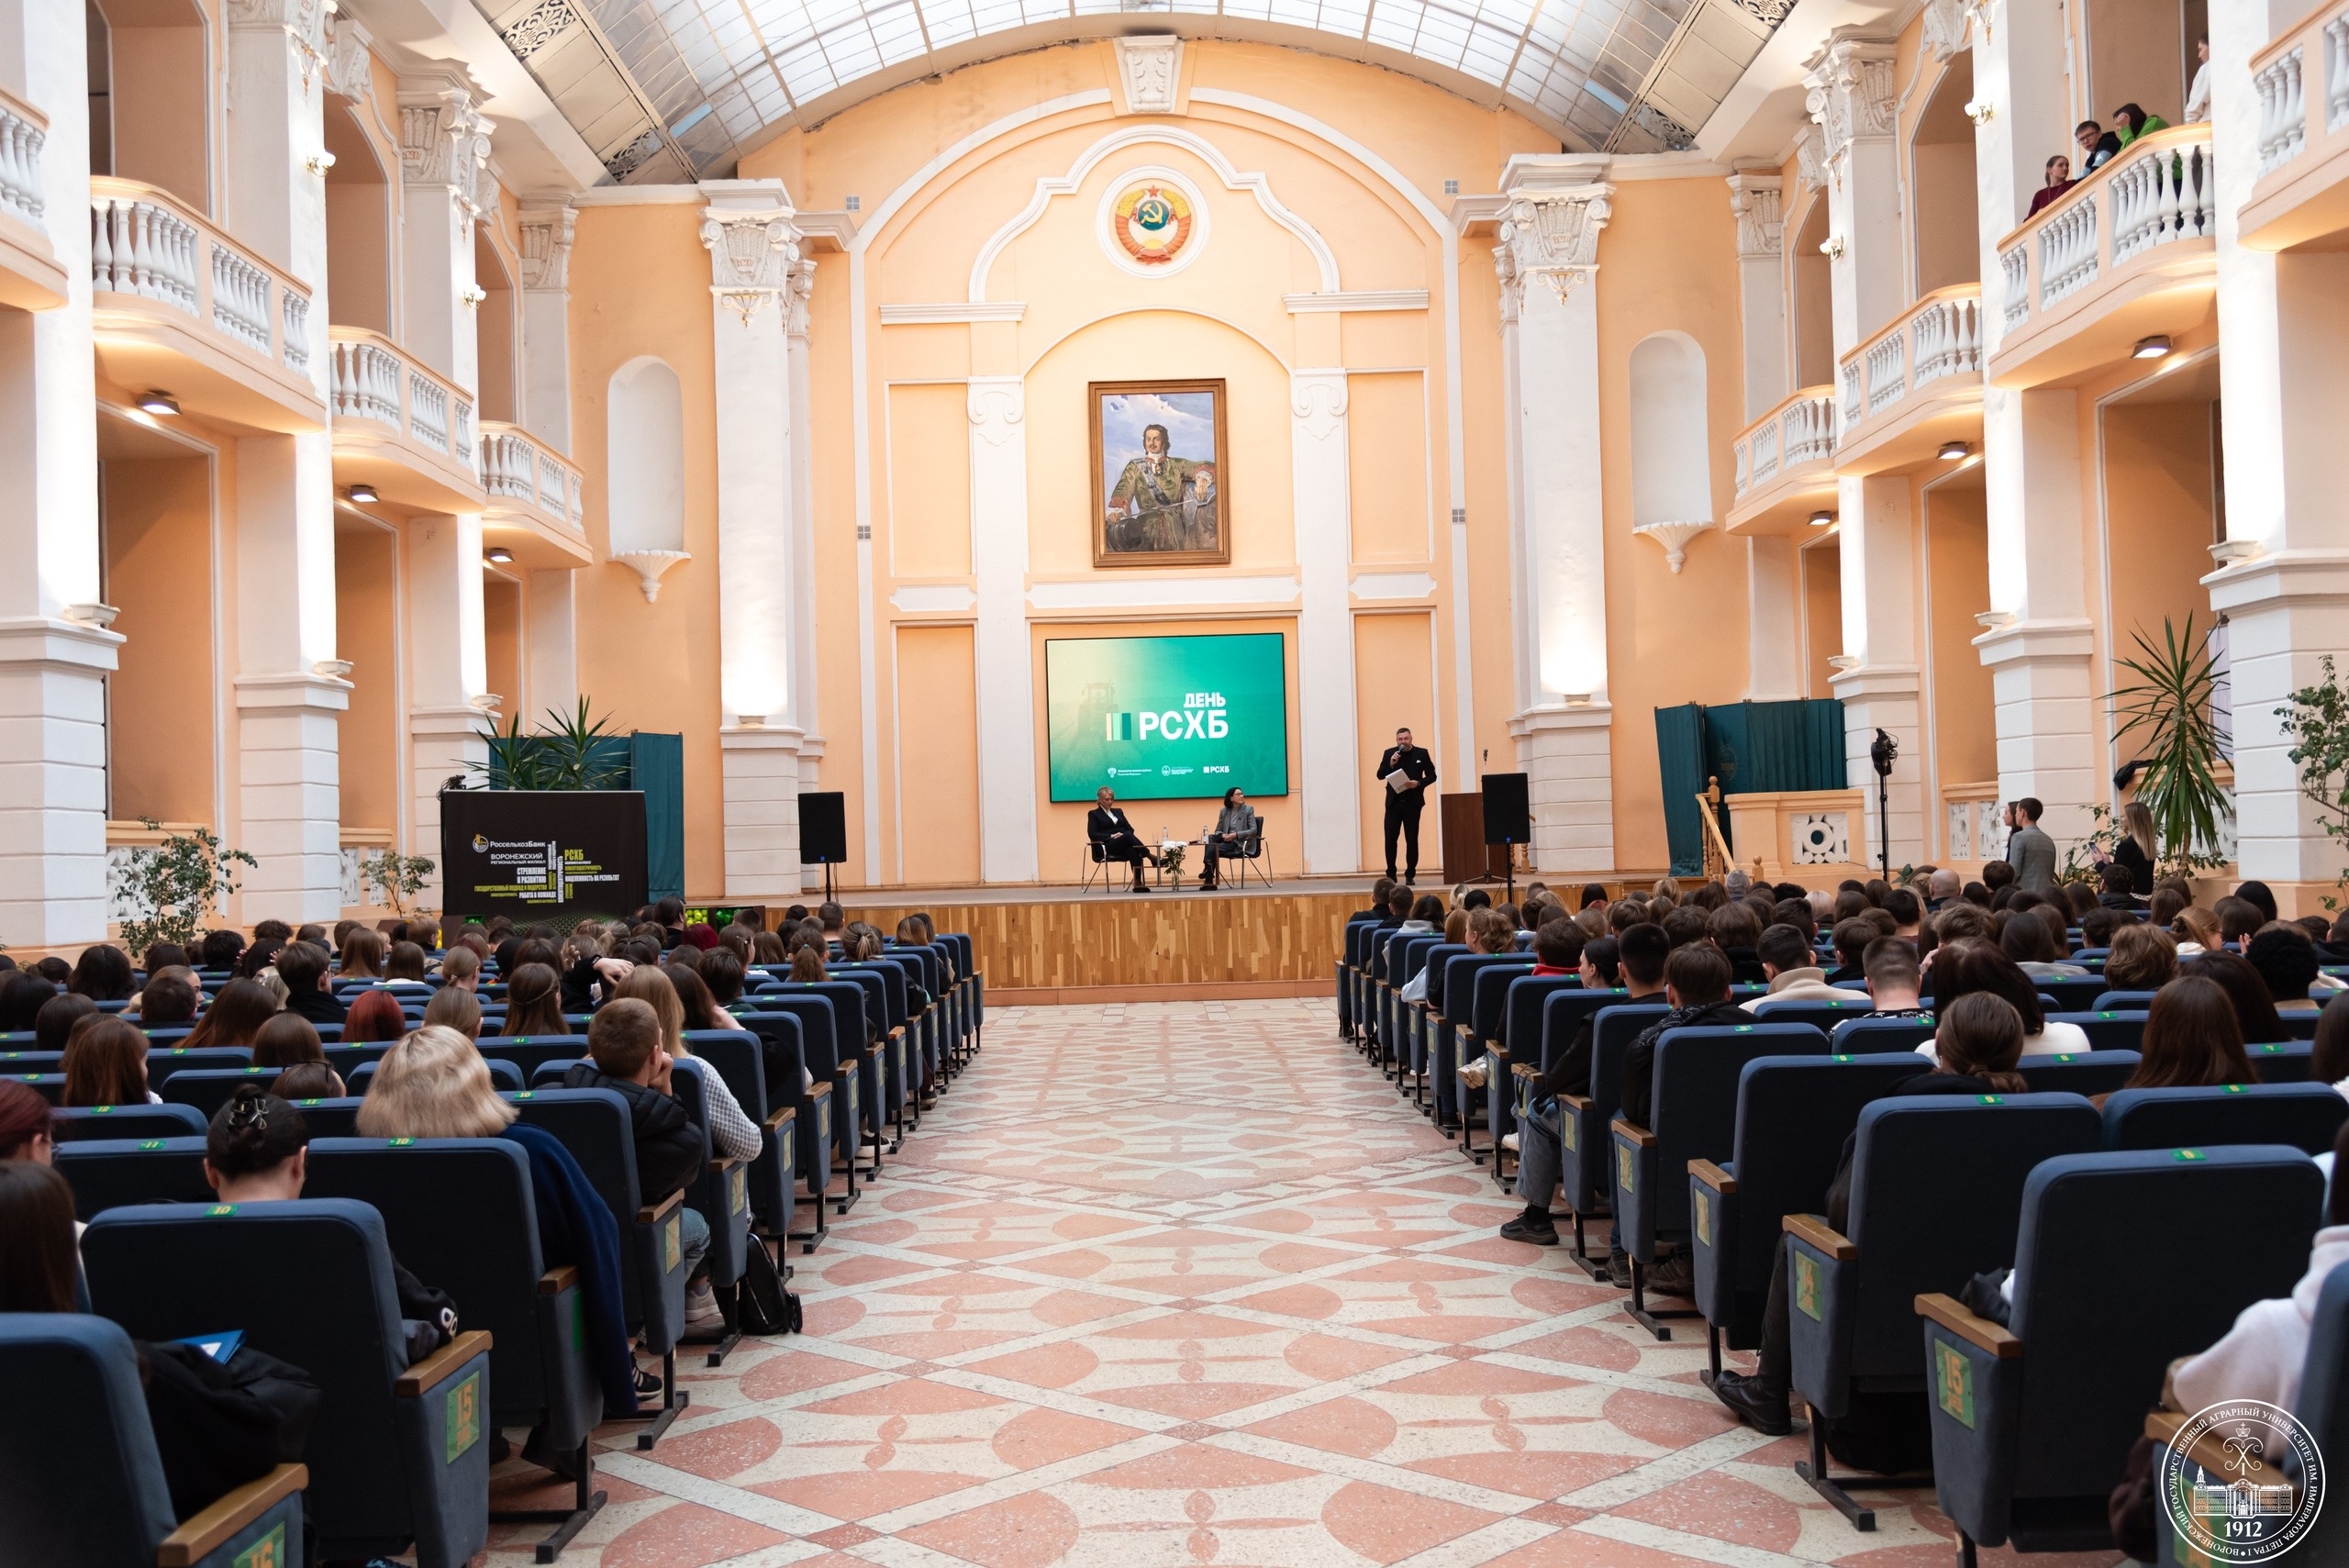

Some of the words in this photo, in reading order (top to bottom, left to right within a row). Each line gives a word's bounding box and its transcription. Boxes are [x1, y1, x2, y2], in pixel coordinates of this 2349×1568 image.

[1184, 692, 1226, 708] ДЕНЬ
[1139, 710, 1229, 740] РСХБ
[1209, 765, 1230, 773] РСХБ
[564, 849, 584, 861] РСХБ
[517, 867, 546, 875] СТРЕМЛЕНИЕ
[214, 1206, 232, 1215] 10
[1944, 1350, 1964, 1396] 15
[457, 1381, 473, 1425] 15
